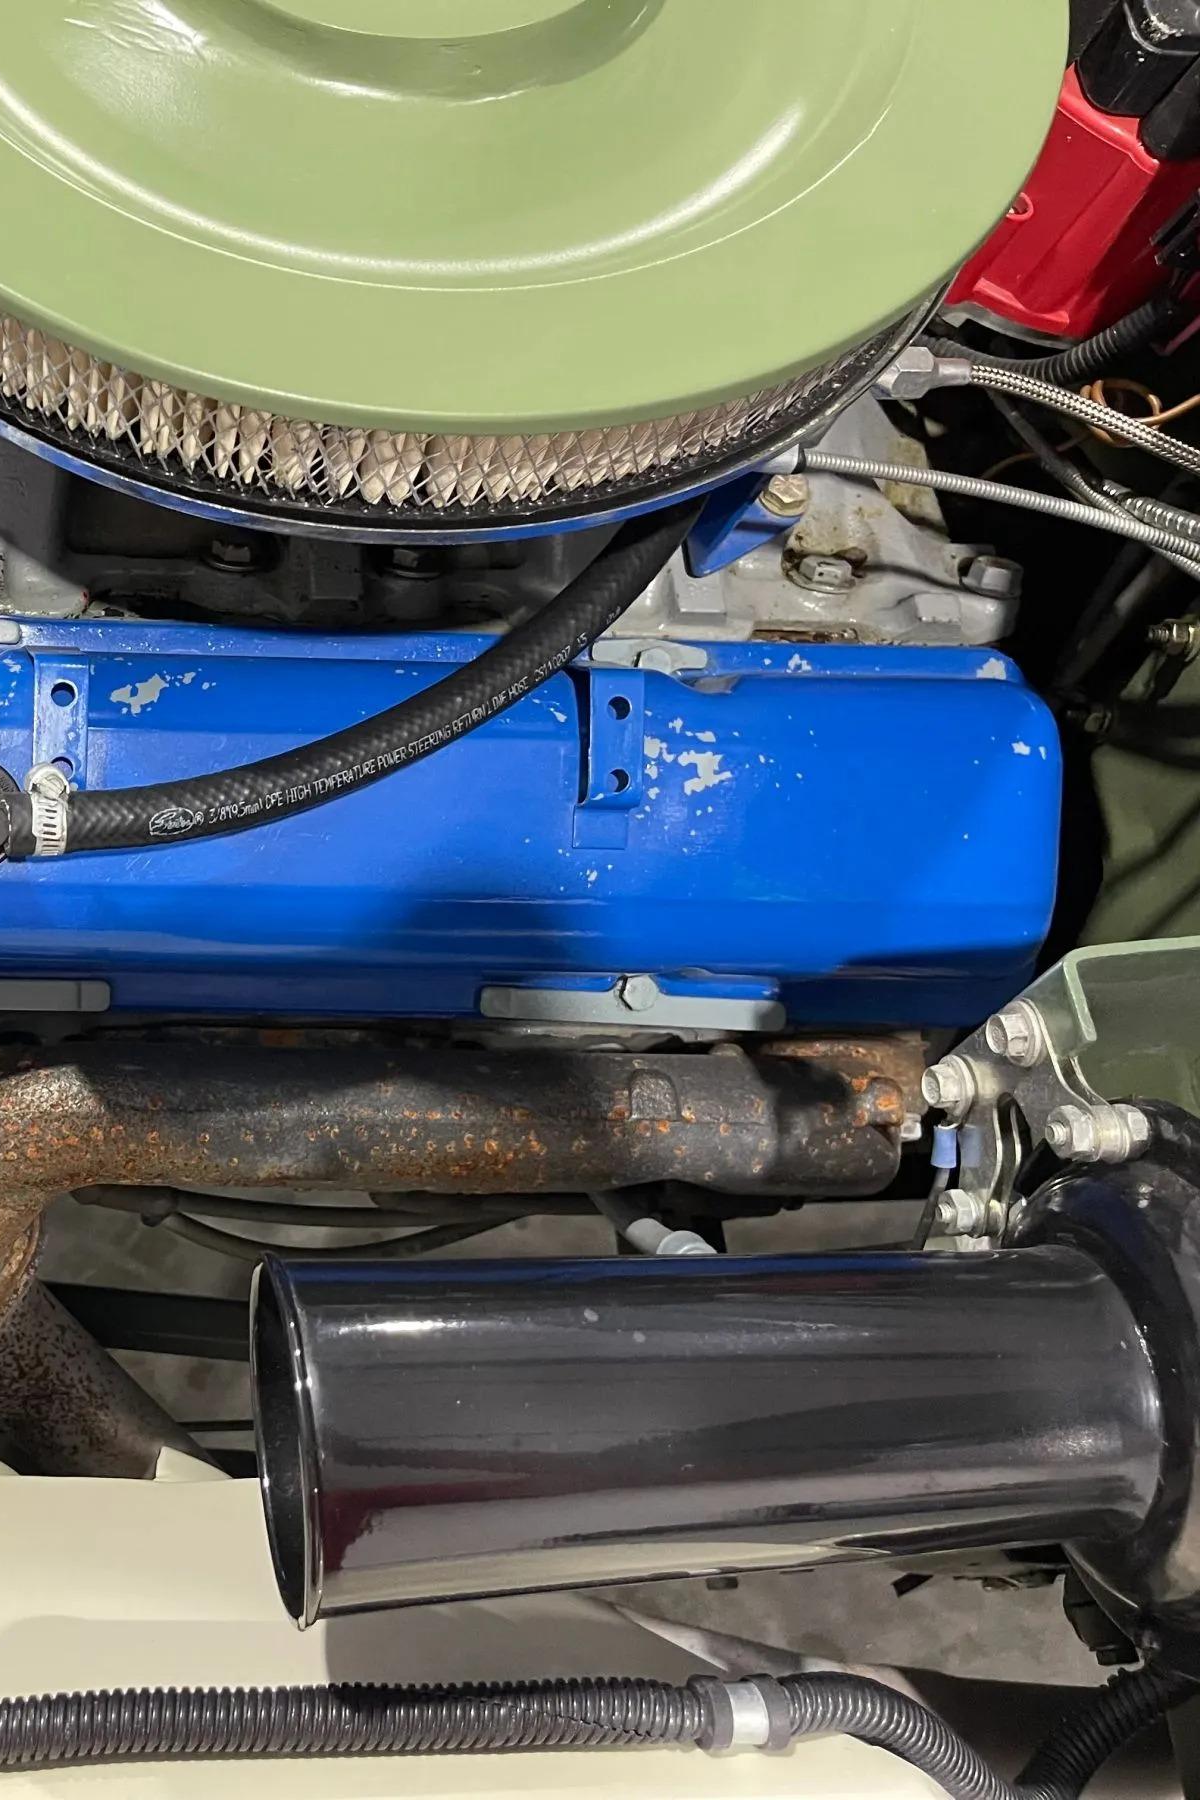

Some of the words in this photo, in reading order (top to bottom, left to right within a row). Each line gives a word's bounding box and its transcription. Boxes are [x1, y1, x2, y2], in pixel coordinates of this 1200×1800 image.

[286, 783, 311, 805] HIGH
[312, 758, 376, 796] TEMPERATURE
[377, 746, 408, 771] POWER
[408, 724, 452, 758] STEERING
[451, 703, 487, 735] RETURN
[507, 676, 529, 700] HOSE
